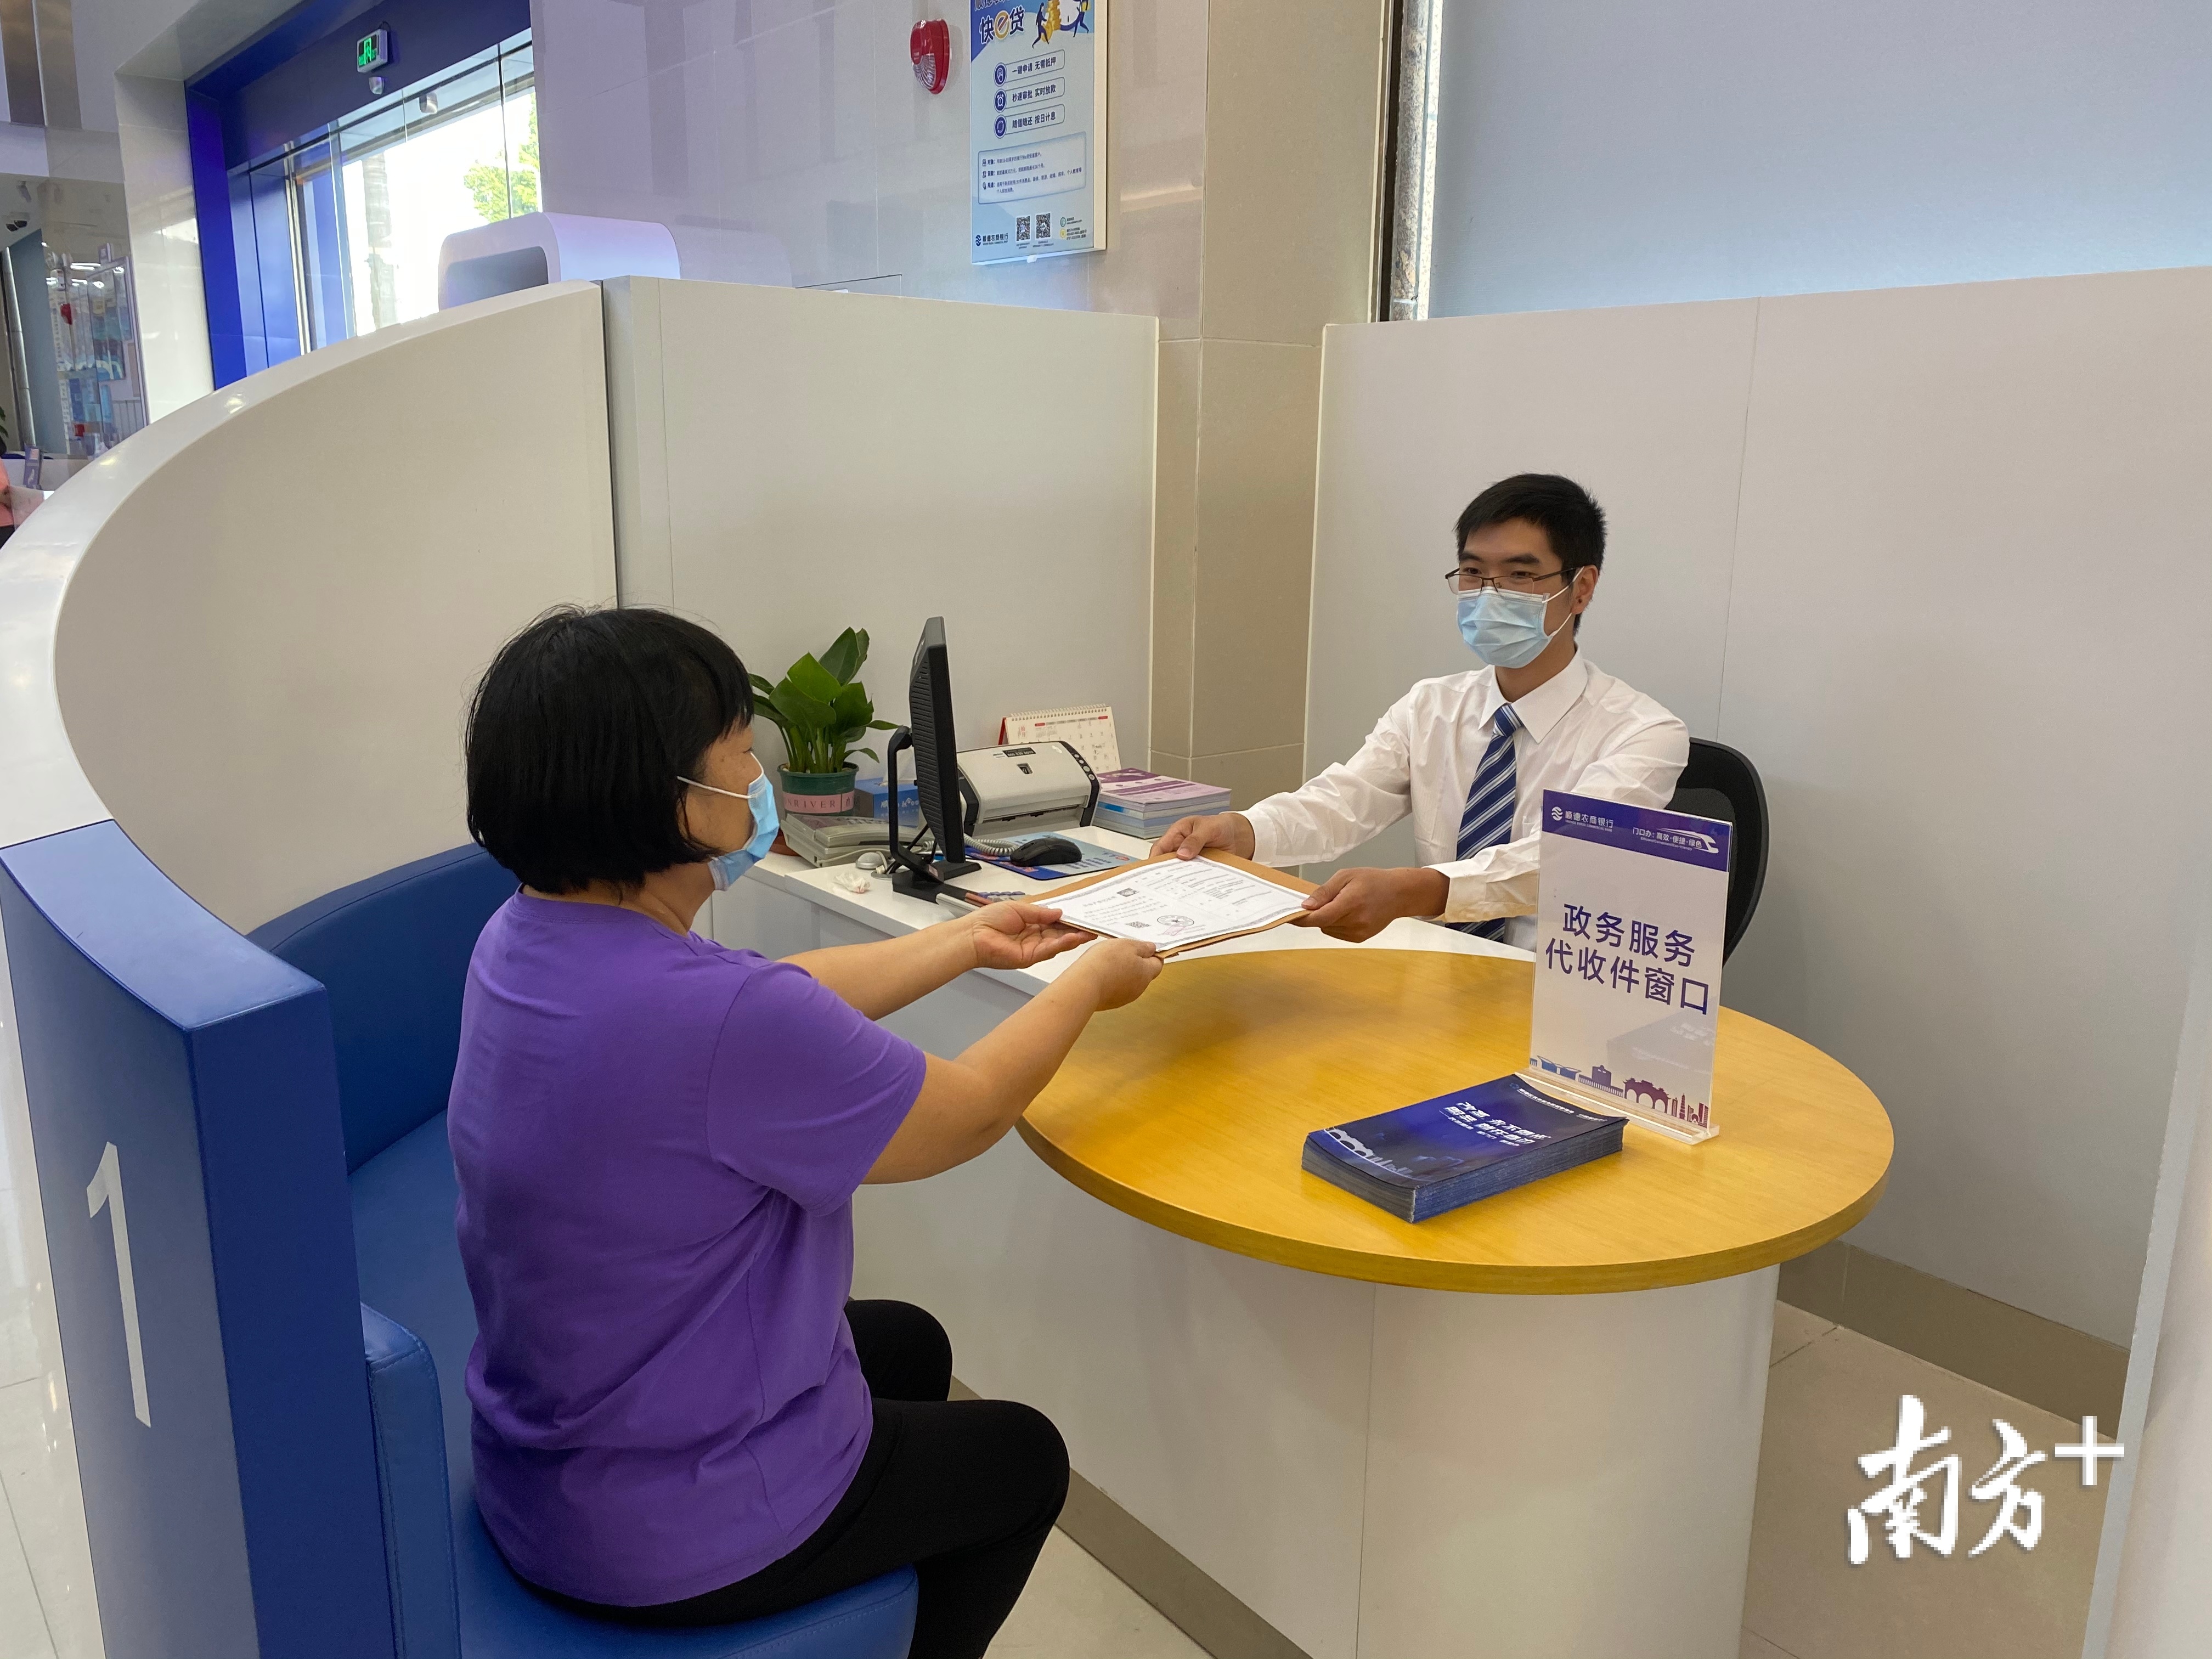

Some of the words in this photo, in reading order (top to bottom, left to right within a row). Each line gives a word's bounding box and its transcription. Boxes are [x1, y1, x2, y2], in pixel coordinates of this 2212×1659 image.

[1012, 63, 1032, 75] 一键申请
[1035, 57, 1056, 70] 无需抵押
[1012, 89, 1032, 102] 秒速审批
[1035, 83, 1056, 97] 实时放款
[1012, 116, 1032, 128] 随借随还
[1035, 111, 1056, 124] 按日计息
[1565, 810, 1614, 828] 顺德农商银行
[1562, 903, 1695, 967] 政务服务
[1545, 938, 1709, 1015] 代收件窗口
[86, 1141, 151, 1428] 1
